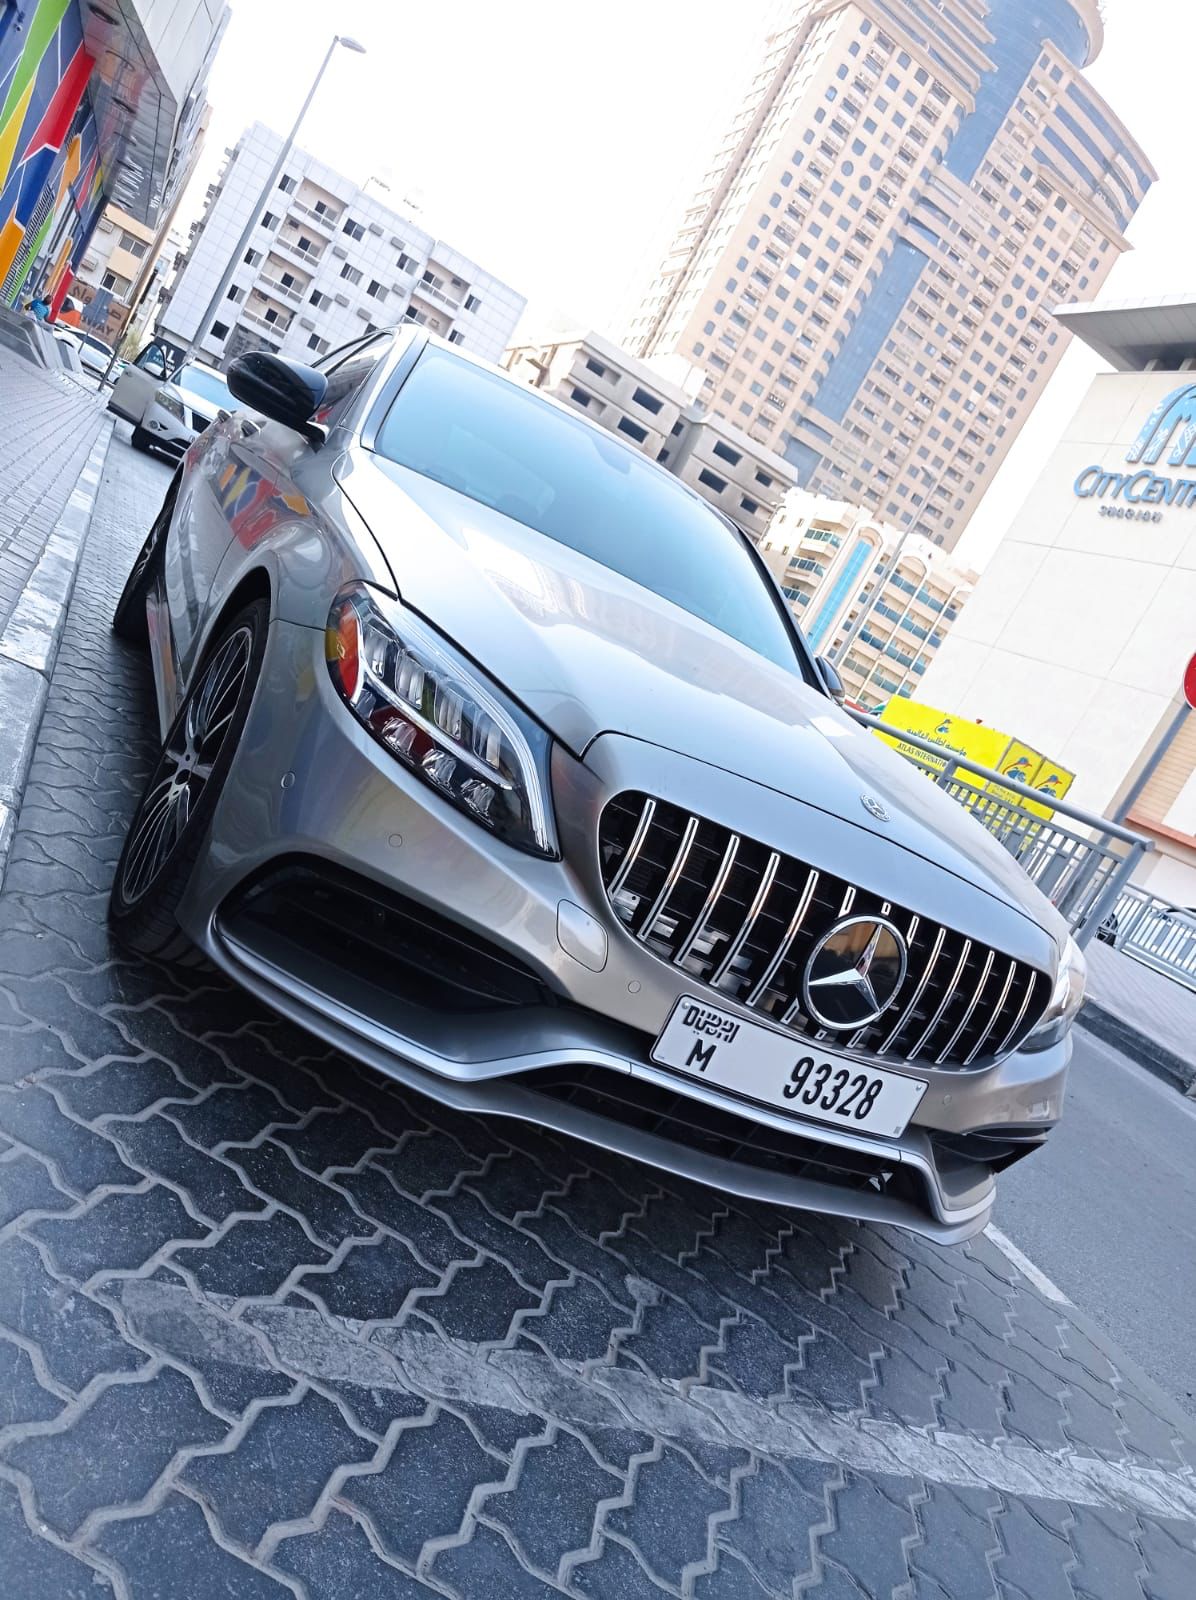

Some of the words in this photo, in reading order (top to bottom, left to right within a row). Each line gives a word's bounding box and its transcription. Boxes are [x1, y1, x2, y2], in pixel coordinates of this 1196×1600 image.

[897, 743, 915, 755] ATLAS
[685, 1039, 717, 1072] M
[783, 1056, 884, 1120] 93328
